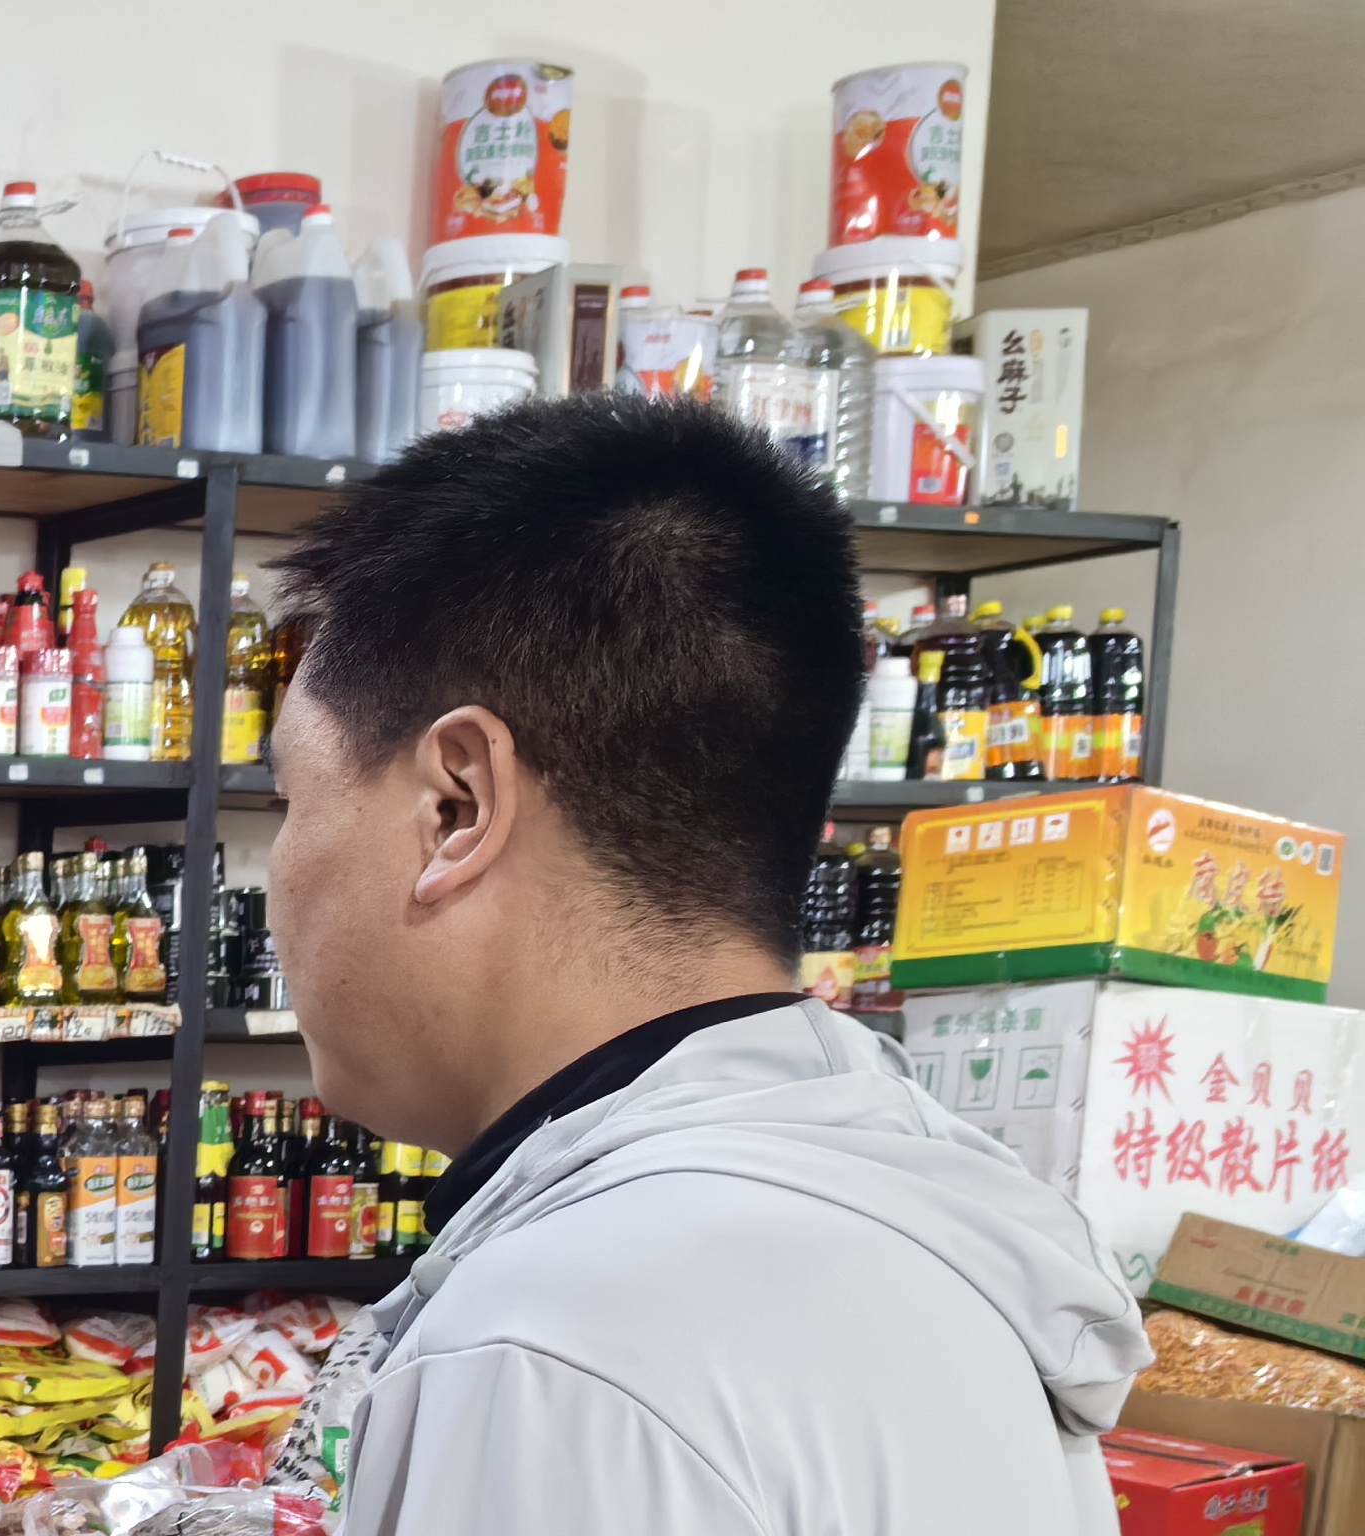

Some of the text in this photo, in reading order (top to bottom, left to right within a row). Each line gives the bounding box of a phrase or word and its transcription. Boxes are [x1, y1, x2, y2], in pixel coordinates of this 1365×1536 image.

[1198, 1051, 1313, 1115] 金贝贝
[1113, 1107, 1350, 1204] 特级散片纸
